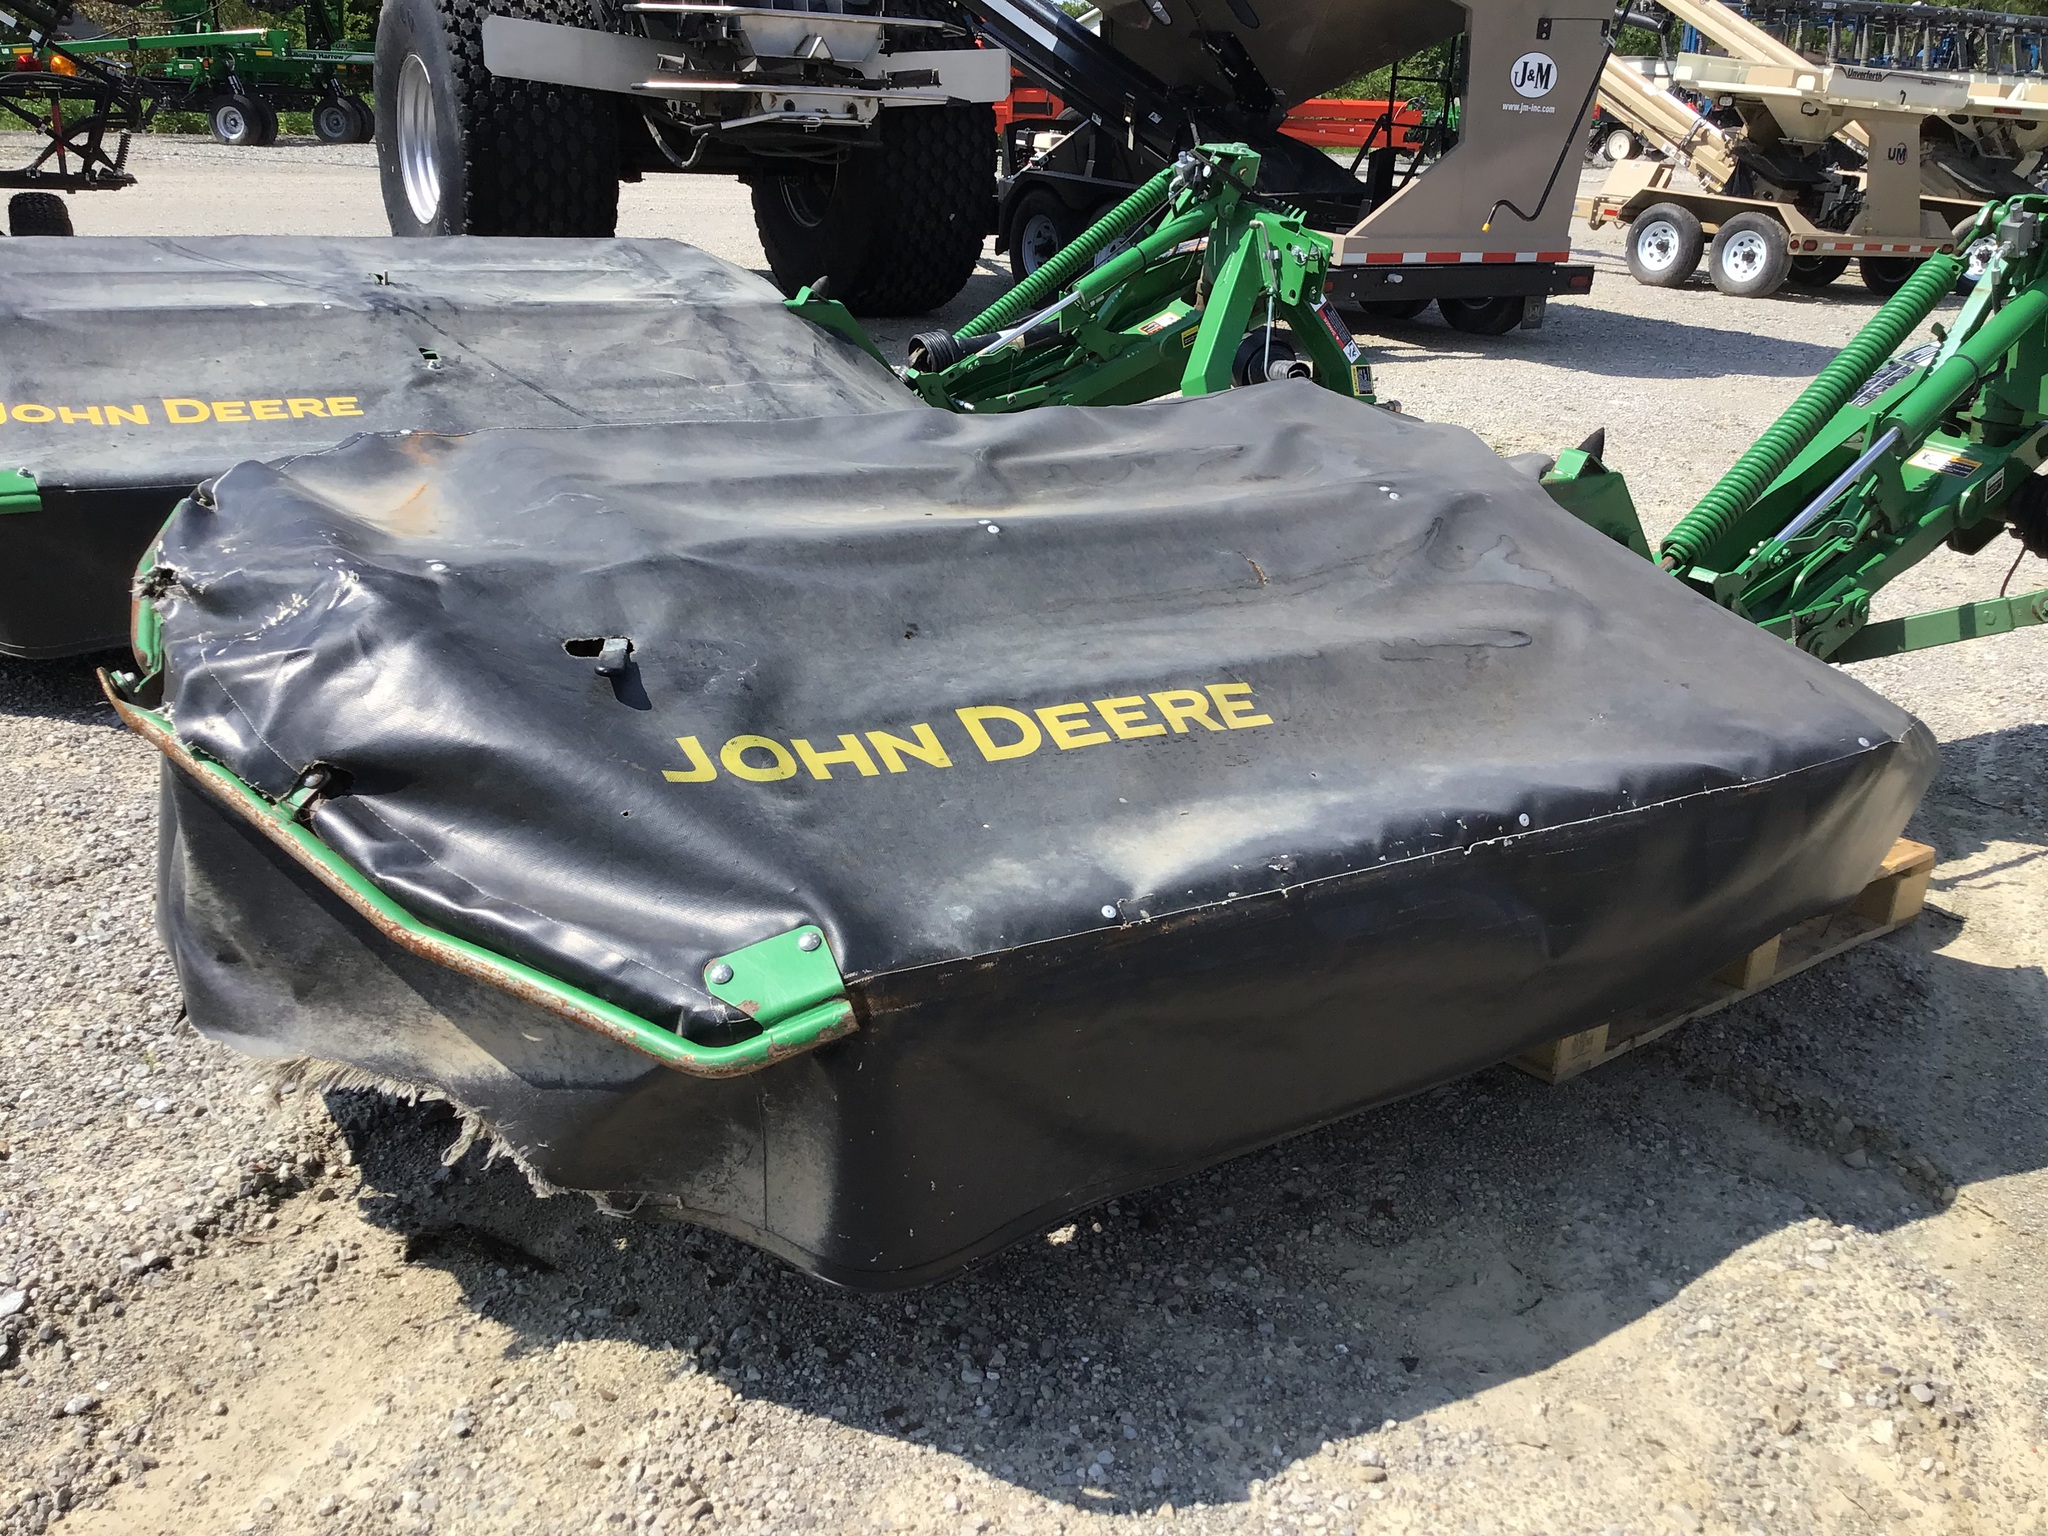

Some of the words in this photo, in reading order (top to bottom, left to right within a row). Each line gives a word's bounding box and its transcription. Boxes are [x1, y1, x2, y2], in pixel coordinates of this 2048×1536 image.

[1514, 61, 1553, 90] J&M
[1502, 102, 1556, 114] www.jm-inc.com
[162, 396, 365, 424] DEERE
[661, 723, 954, 784] JOHN
[954, 682, 1274, 763] DEERE
